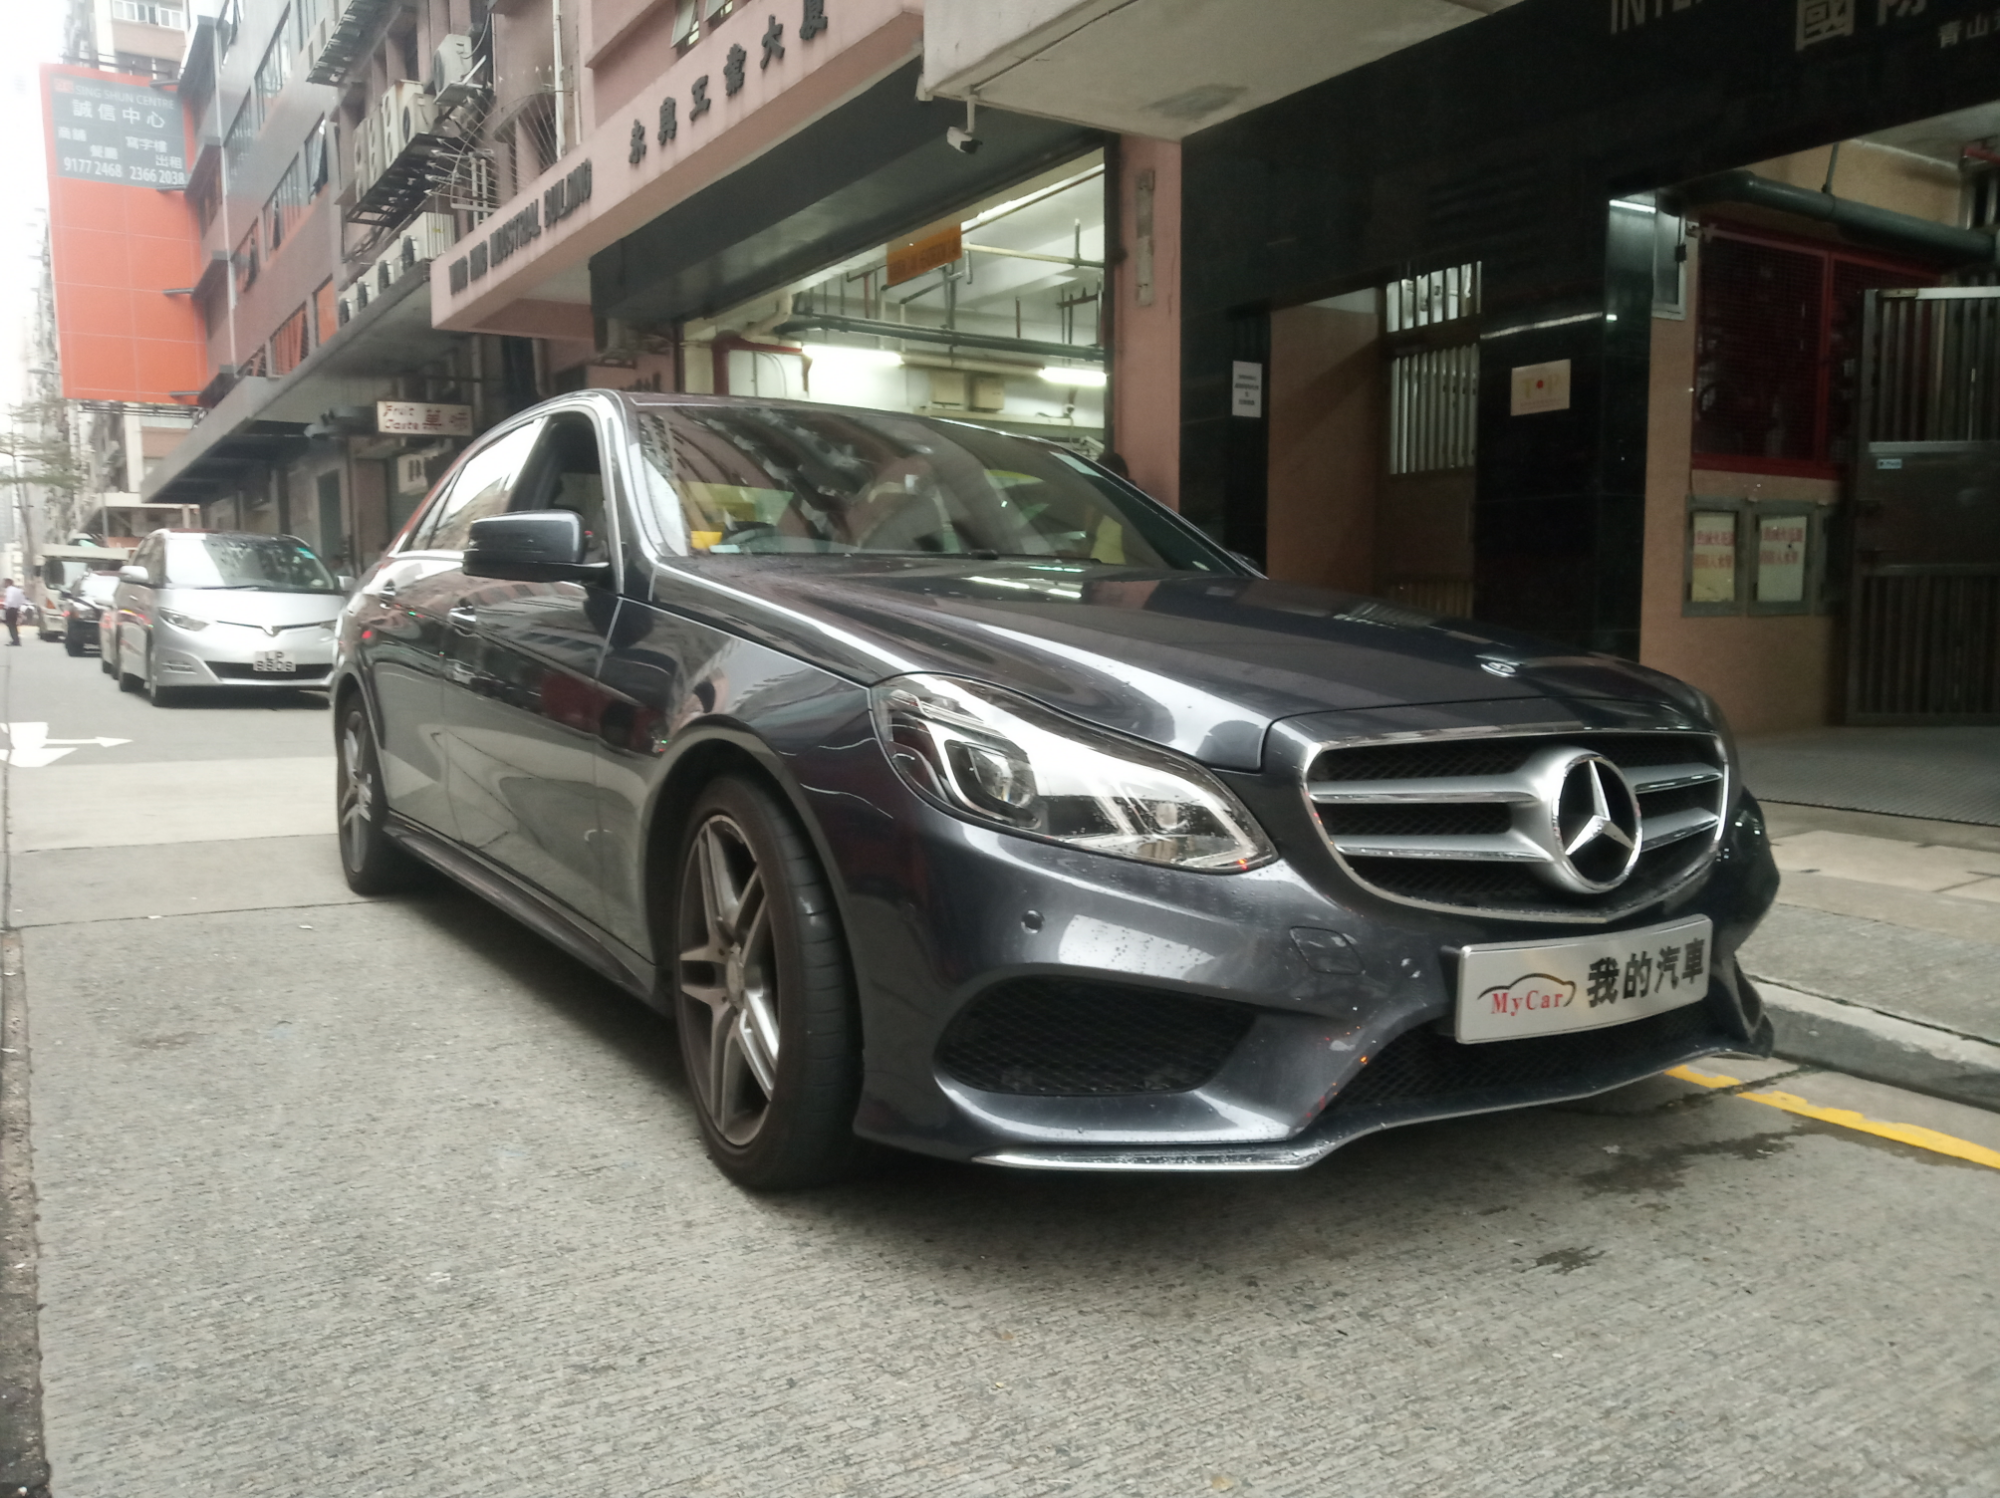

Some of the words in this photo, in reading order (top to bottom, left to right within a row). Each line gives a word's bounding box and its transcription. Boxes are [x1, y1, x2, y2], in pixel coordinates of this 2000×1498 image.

[1938, 15, 2000, 49] 青山
[75, 84, 101, 98] SING
[104, 89, 134, 104] SHUN
[136, 94, 175, 110] CENTRE
[72, 98, 165, 129] 誠信中心
[64, 157, 92, 174] 9177
[94, 161, 123, 178] 2468
[129, 166, 157, 182] 2366
[159, 169, 185, 185] 2038
[1491, 989, 1563, 1017] MyCar
[1587, 938, 1705, 1008] 我的汽車
